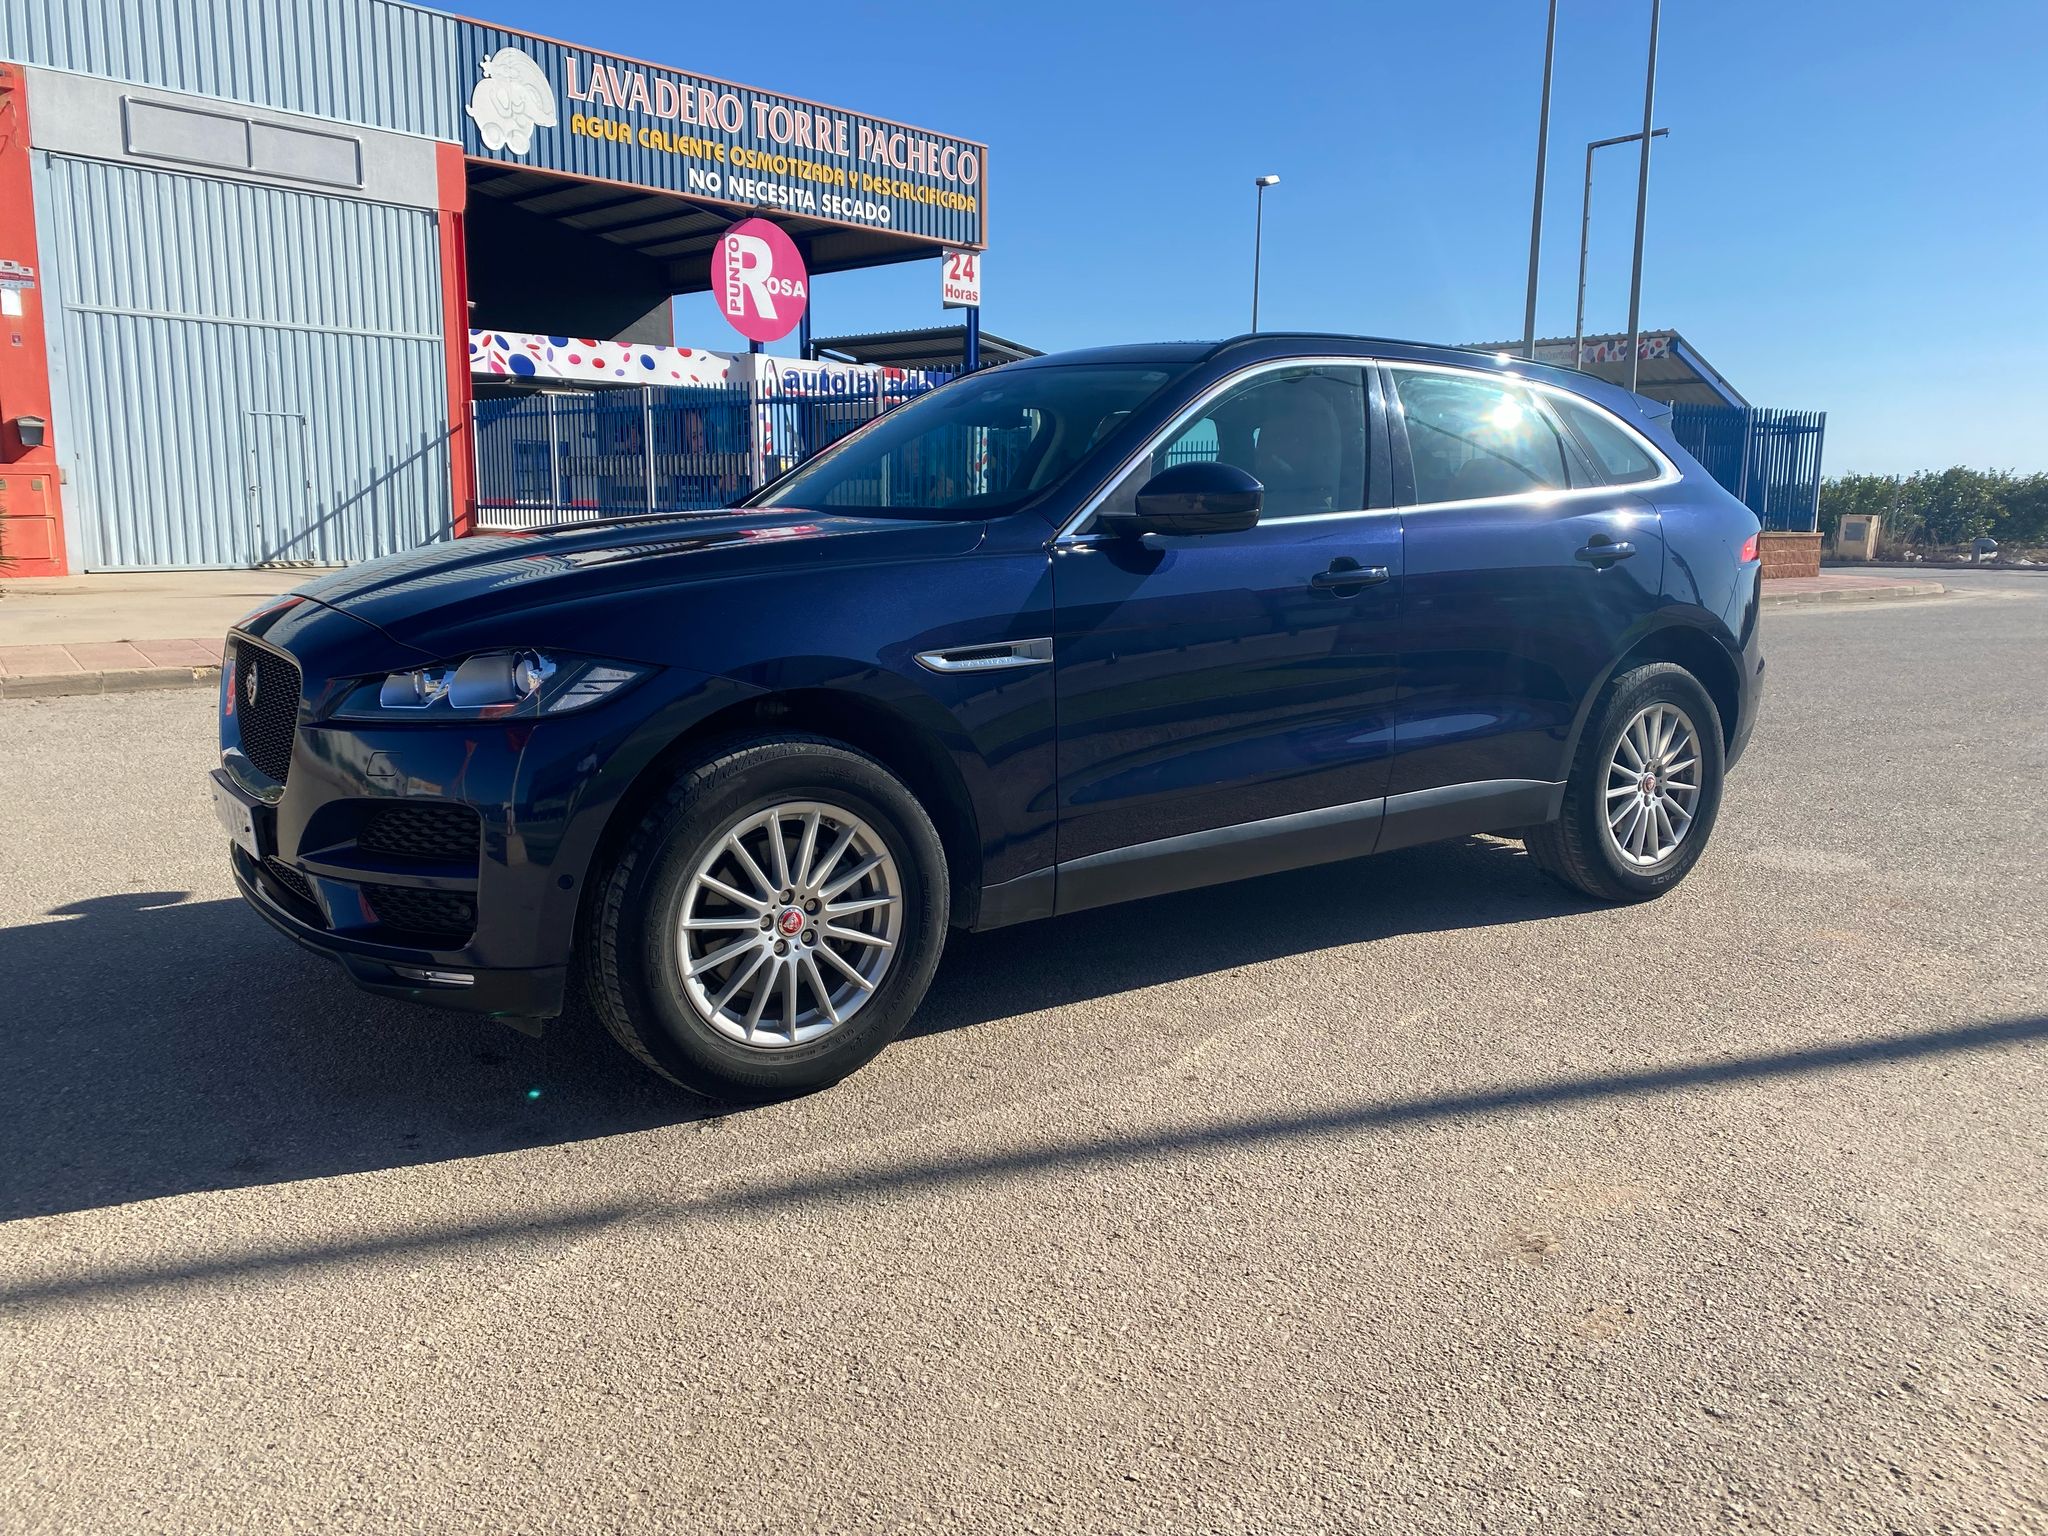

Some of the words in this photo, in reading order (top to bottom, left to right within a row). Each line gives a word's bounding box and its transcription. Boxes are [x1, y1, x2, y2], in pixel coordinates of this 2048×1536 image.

[565, 56, 744, 134] LAVADERO
[751, 100, 850, 157] TORRE
[858, 124, 979, 185] PACHECO
[571, 113, 632, 145] AGUA
[638, 127, 725, 163] CALIENTE
[729, 146, 845, 187] OSMOTIZADA
[848, 170, 859, 190] Y
[862, 173, 977, 213] DESCALCIFICADA
[688, 168, 722, 192] NO
[729, 175, 816, 210] NECESITA
[821, 193, 891, 223] SECADO
[728, 237, 741, 312] PUNTO
[945, 283, 979, 302] Horas
[949, 251, 975, 283] 24
